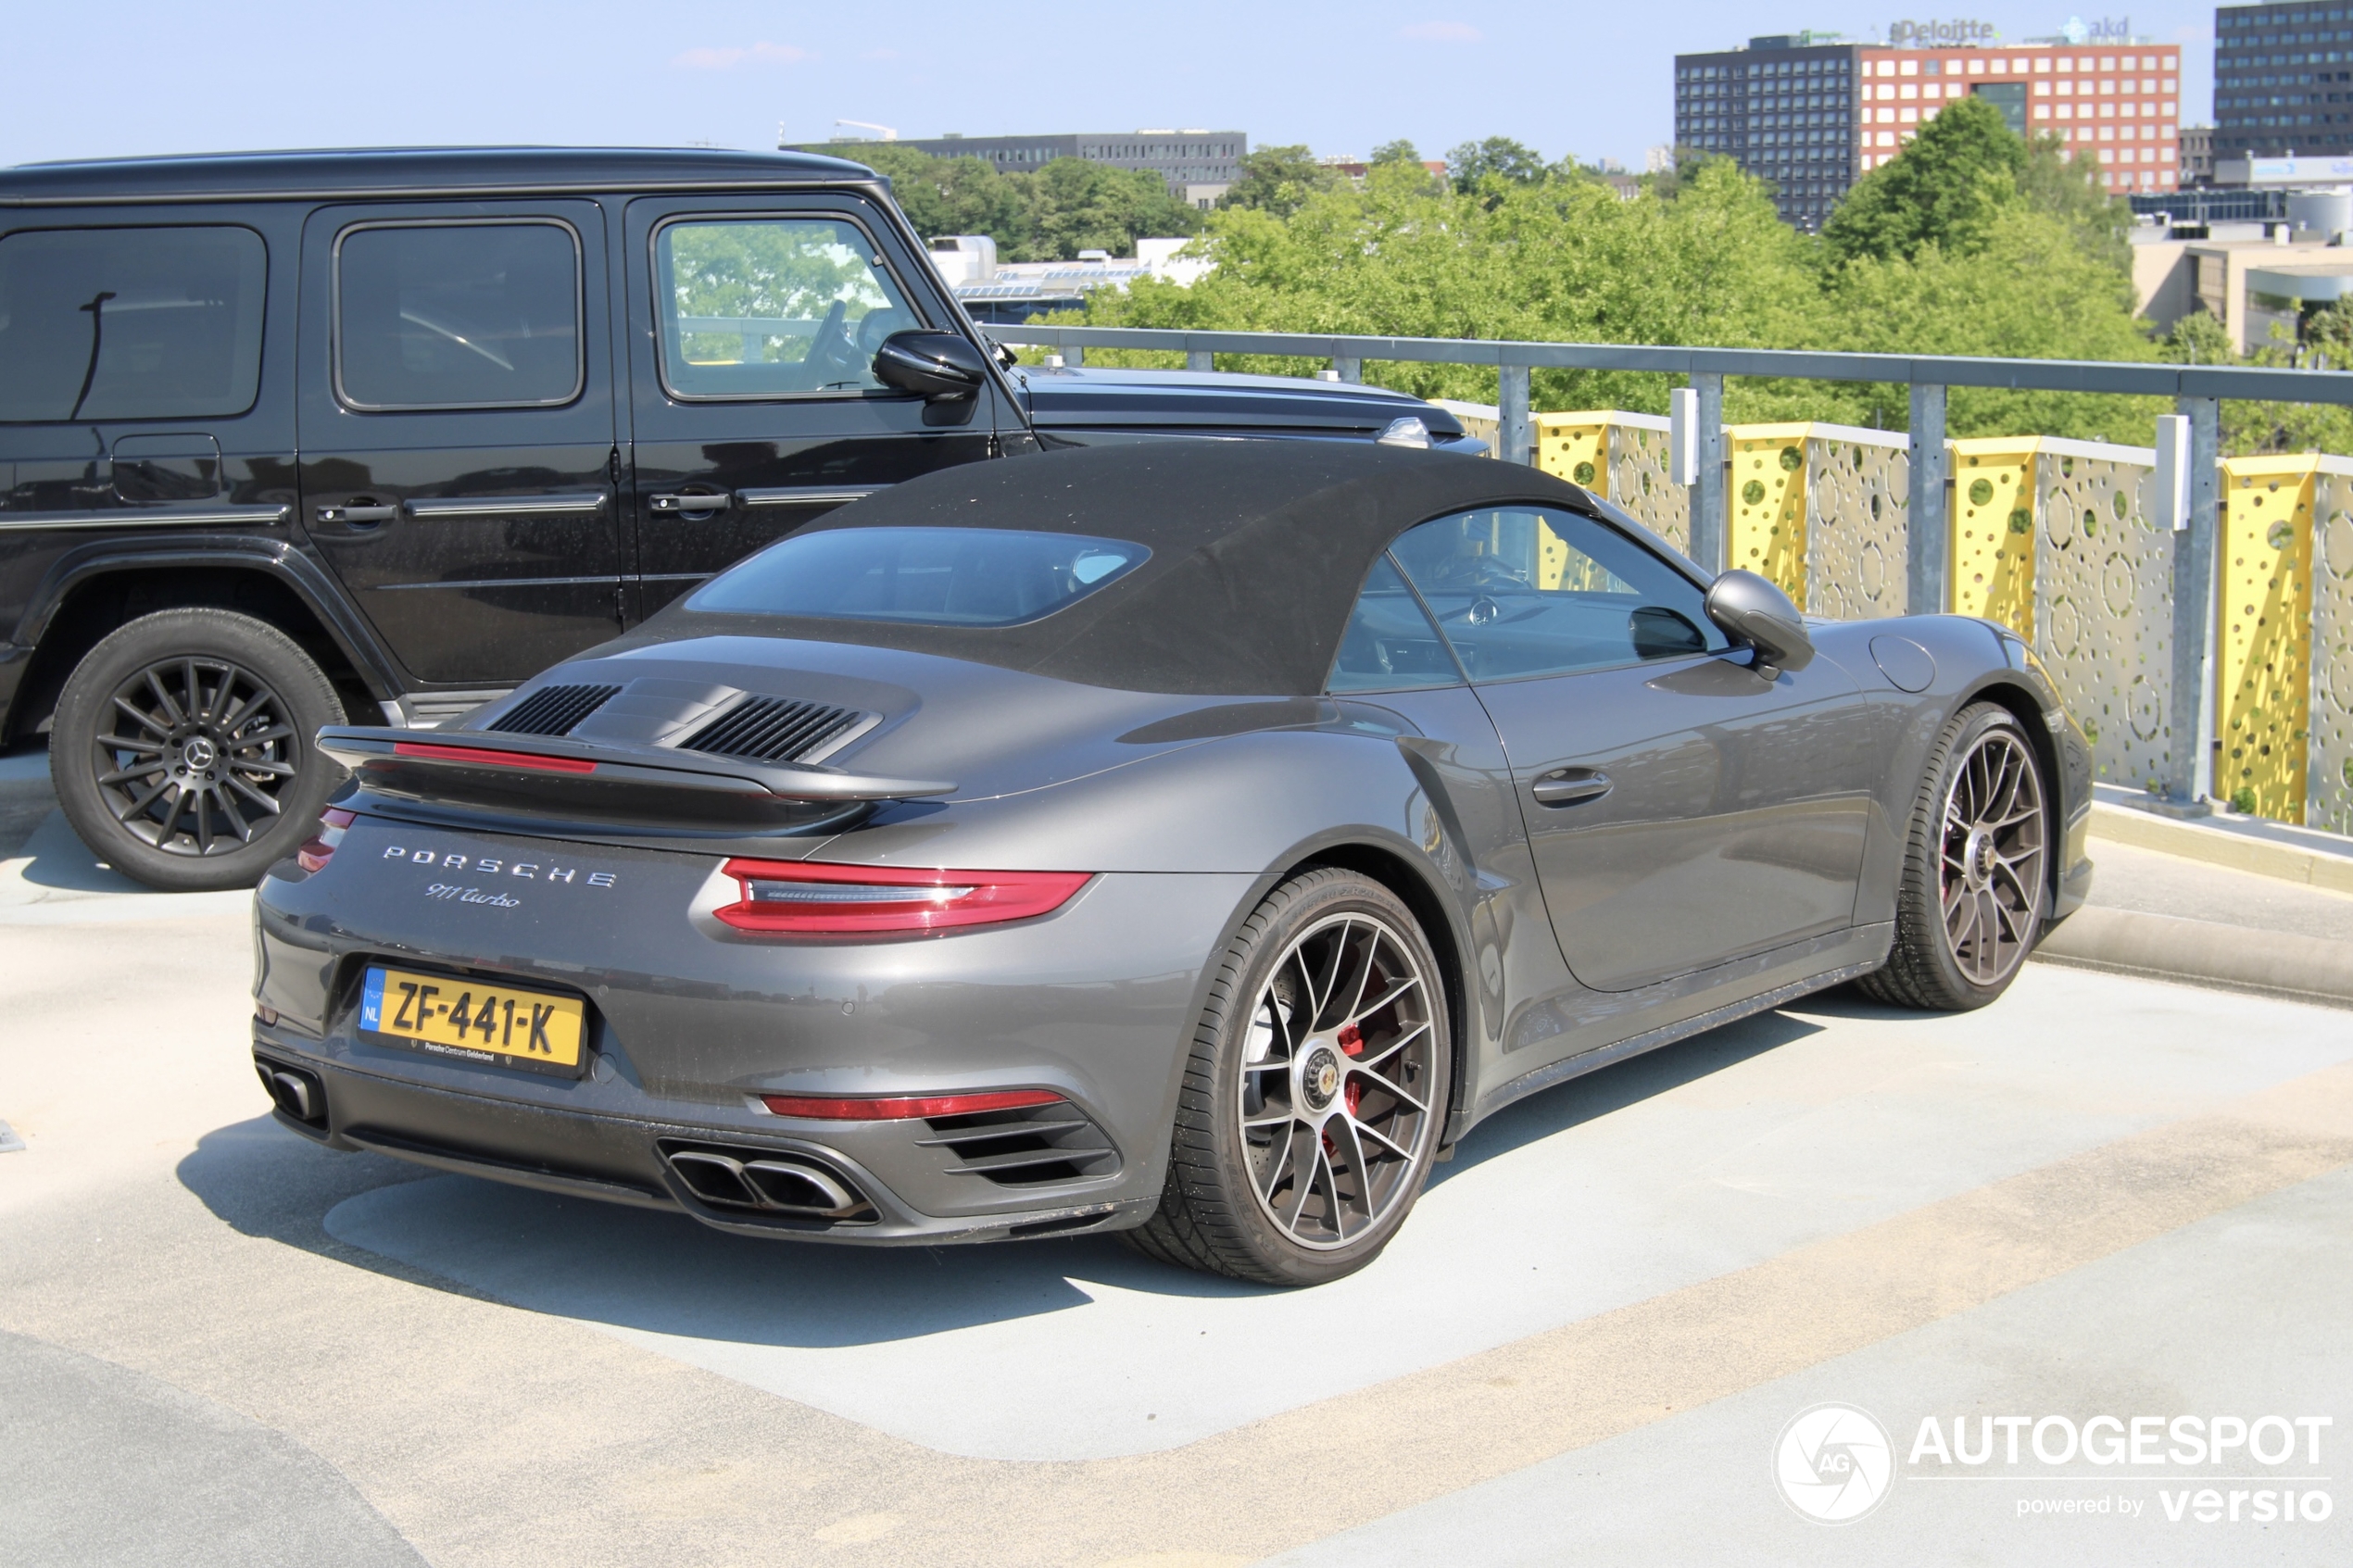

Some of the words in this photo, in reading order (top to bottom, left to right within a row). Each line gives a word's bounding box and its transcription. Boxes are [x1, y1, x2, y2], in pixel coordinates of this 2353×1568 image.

[2089, 18, 2129, 37] akd
[383, 846, 617, 888] PORSCHE
[425, 884, 462, 899] 911
[460, 888, 521, 909] turbo
[364, 1006, 379, 1022] NL
[394, 982, 555, 1054] ZF-441-K
[425, 1042, 446, 1053] Porsche
[445, 1046, 467, 1057] Centrum
[466, 1049, 495, 1061] Gelderland
